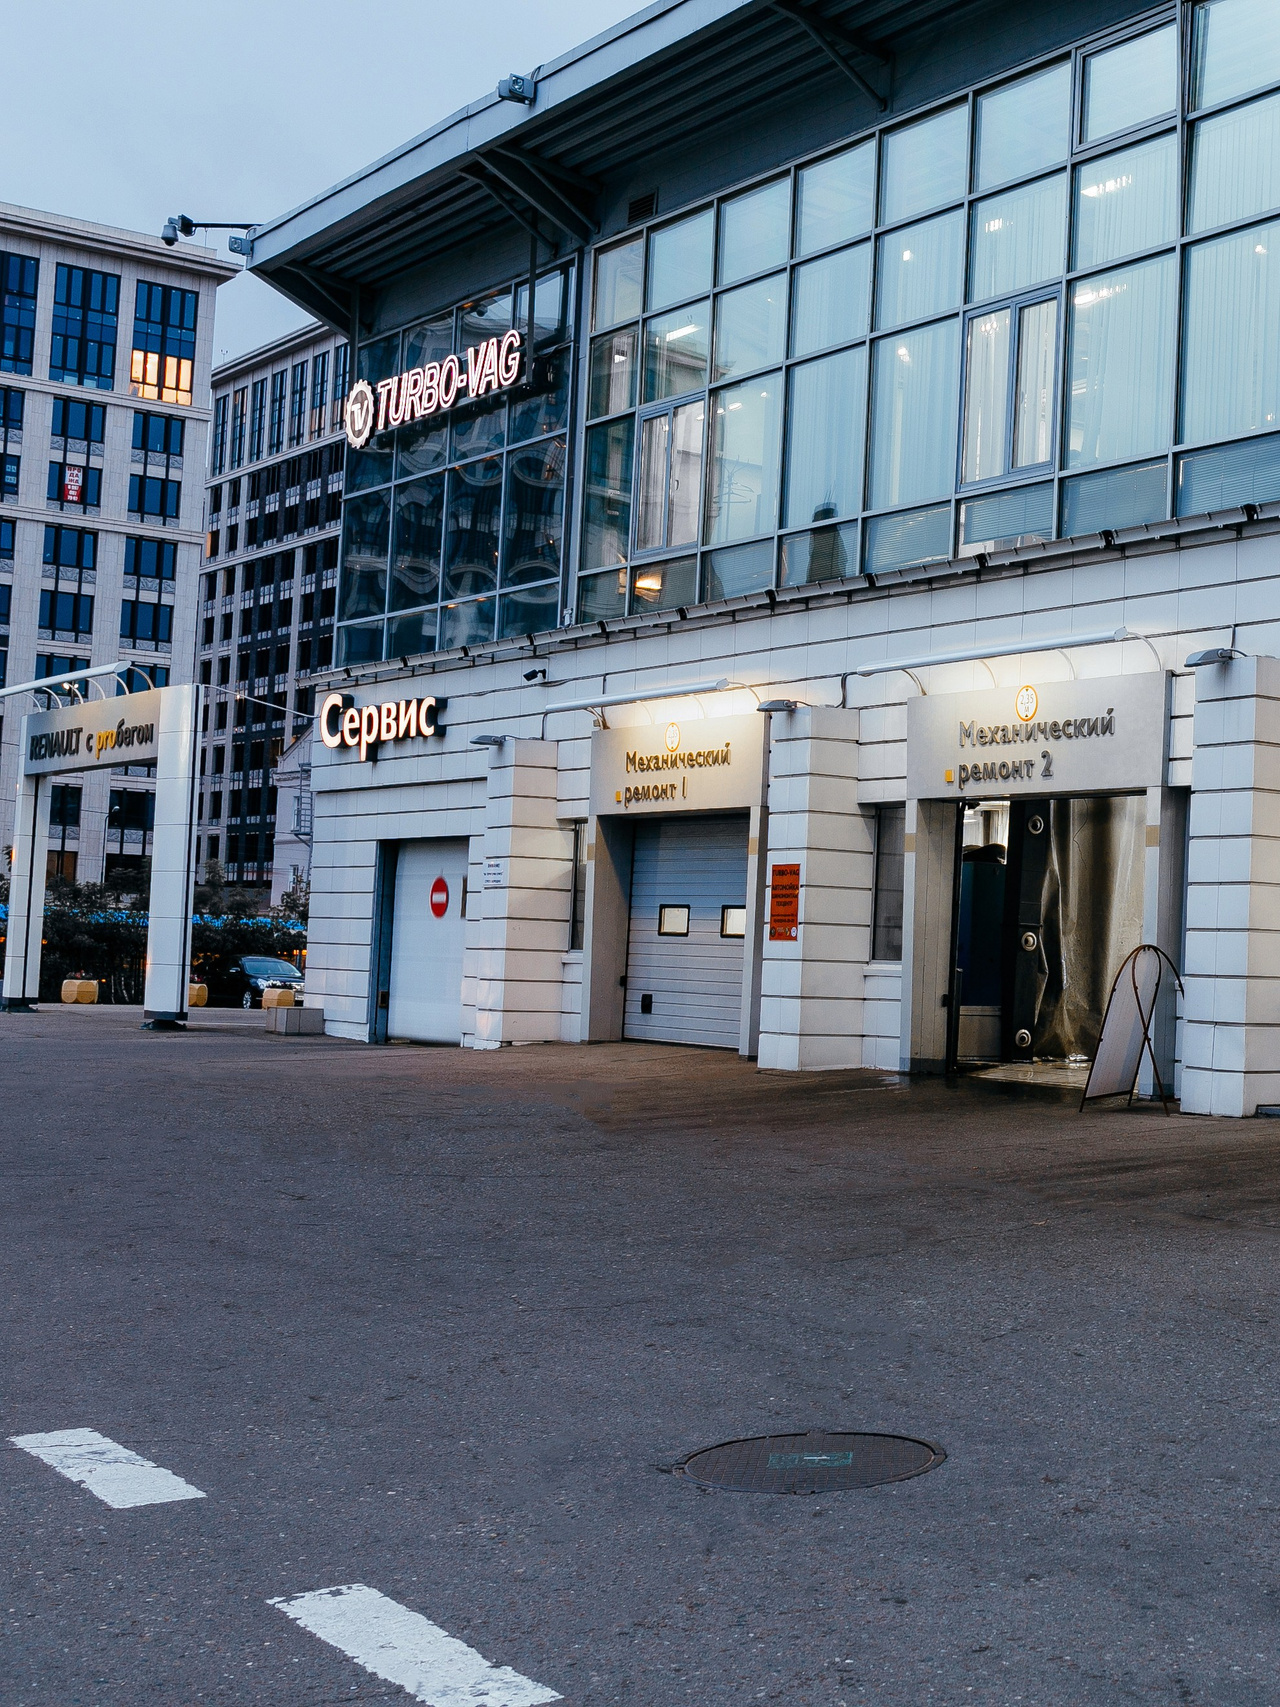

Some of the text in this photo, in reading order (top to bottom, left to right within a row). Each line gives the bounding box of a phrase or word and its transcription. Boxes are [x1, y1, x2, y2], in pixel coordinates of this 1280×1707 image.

[377, 329, 521, 430] TURBO-VAG
[30, 727, 83, 761] RENAULT
[95, 718, 155, 761] proбегом
[320, 692, 440, 762] Сервис
[959, 707, 1116, 747] Механический
[625, 741, 731, 773] Механический
[958, 750, 1054, 790] ремонт 2
[624, 783, 677, 809] ремонт
